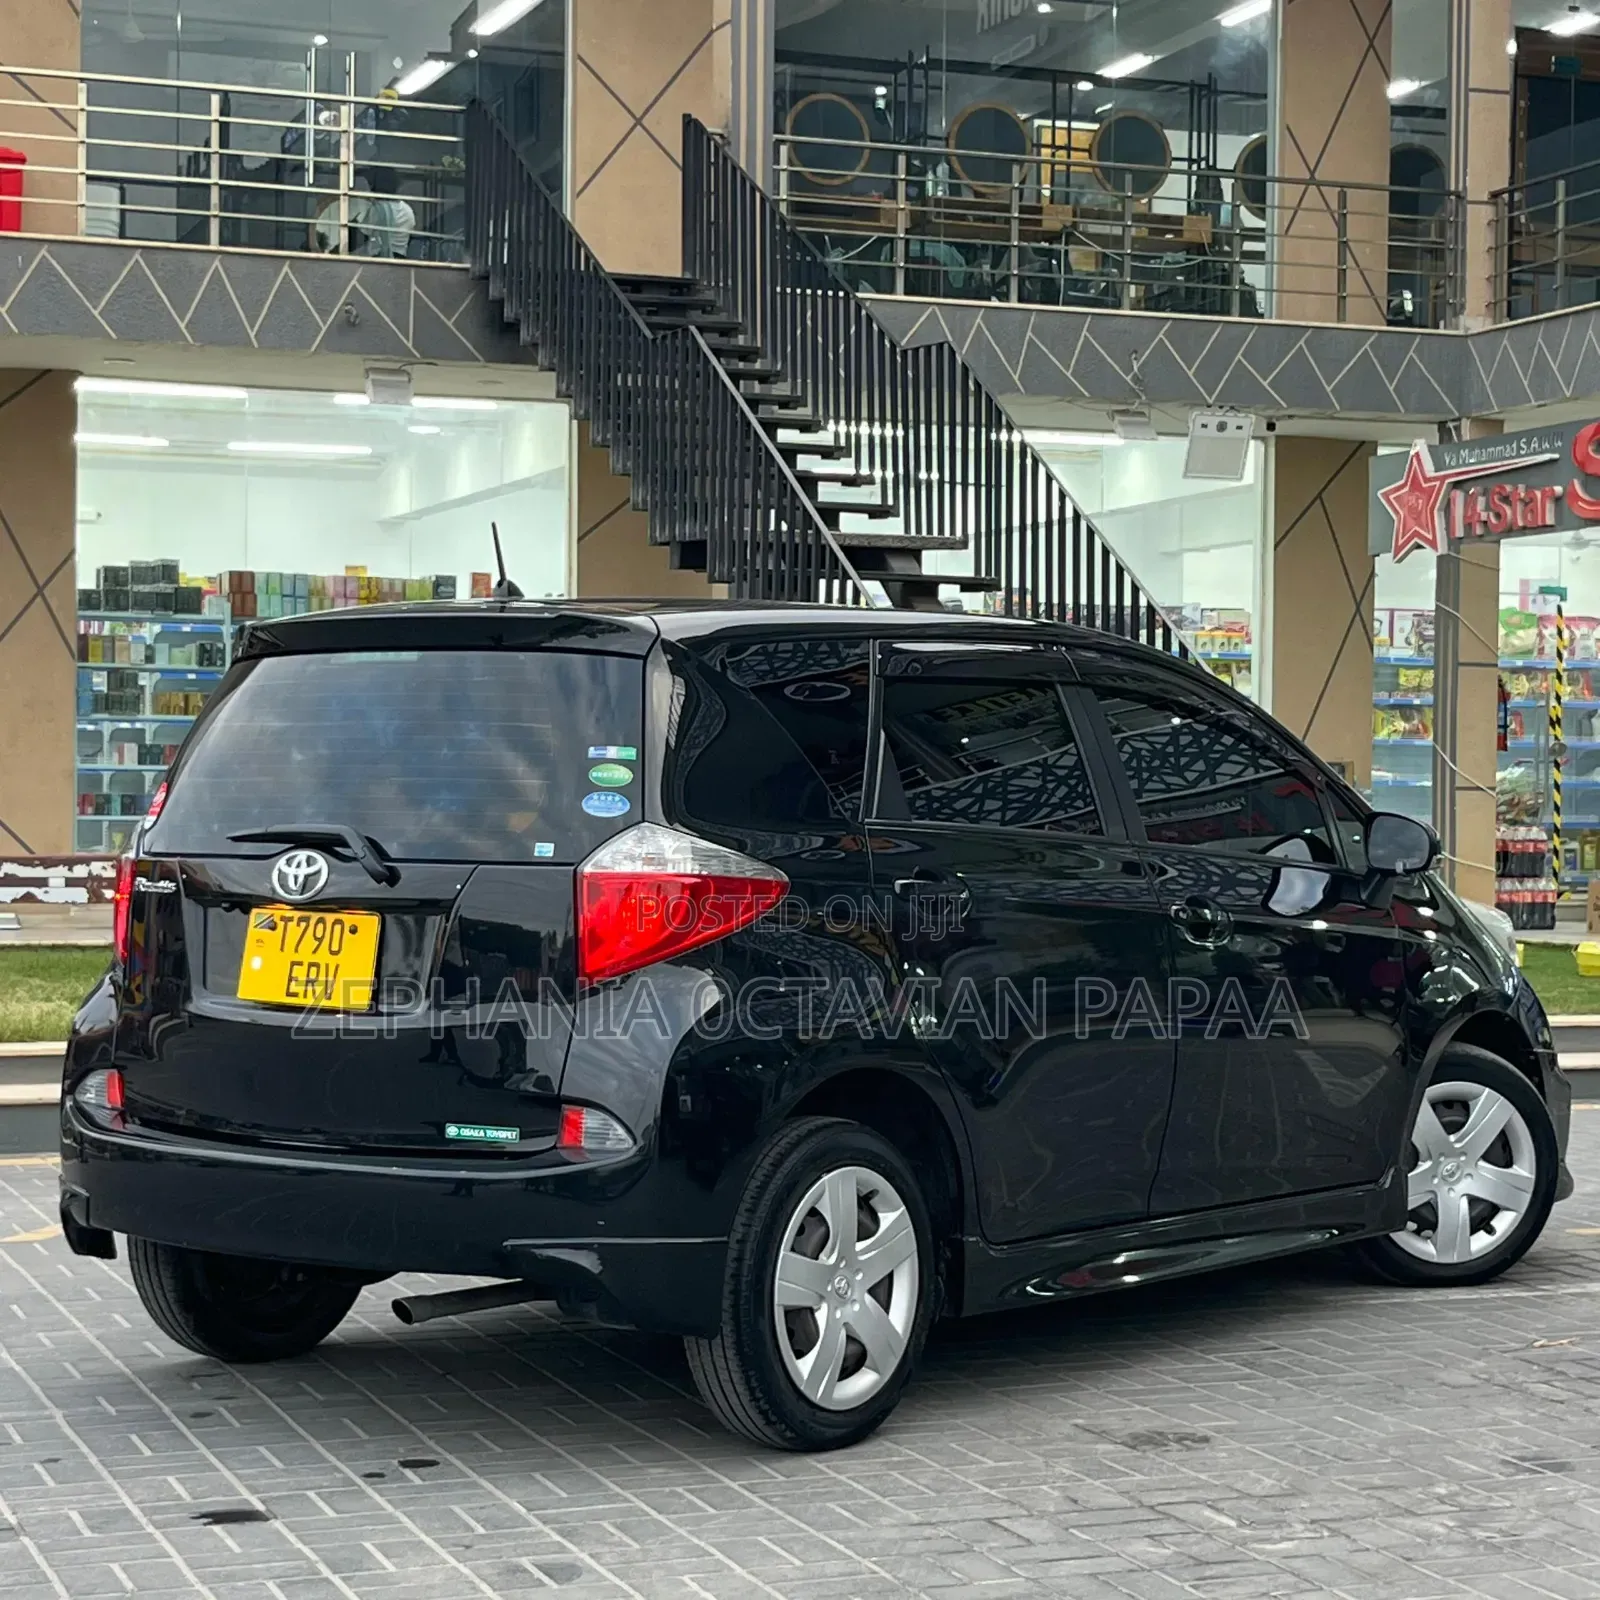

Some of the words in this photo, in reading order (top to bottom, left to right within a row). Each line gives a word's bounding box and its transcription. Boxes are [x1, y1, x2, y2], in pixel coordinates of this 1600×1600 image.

[1458, 439, 1517, 464] Muhammad
[279, 915, 345, 957] T790
[285, 961, 340, 1001] ERV
[459, 1127, 485, 1137] OSAKA
